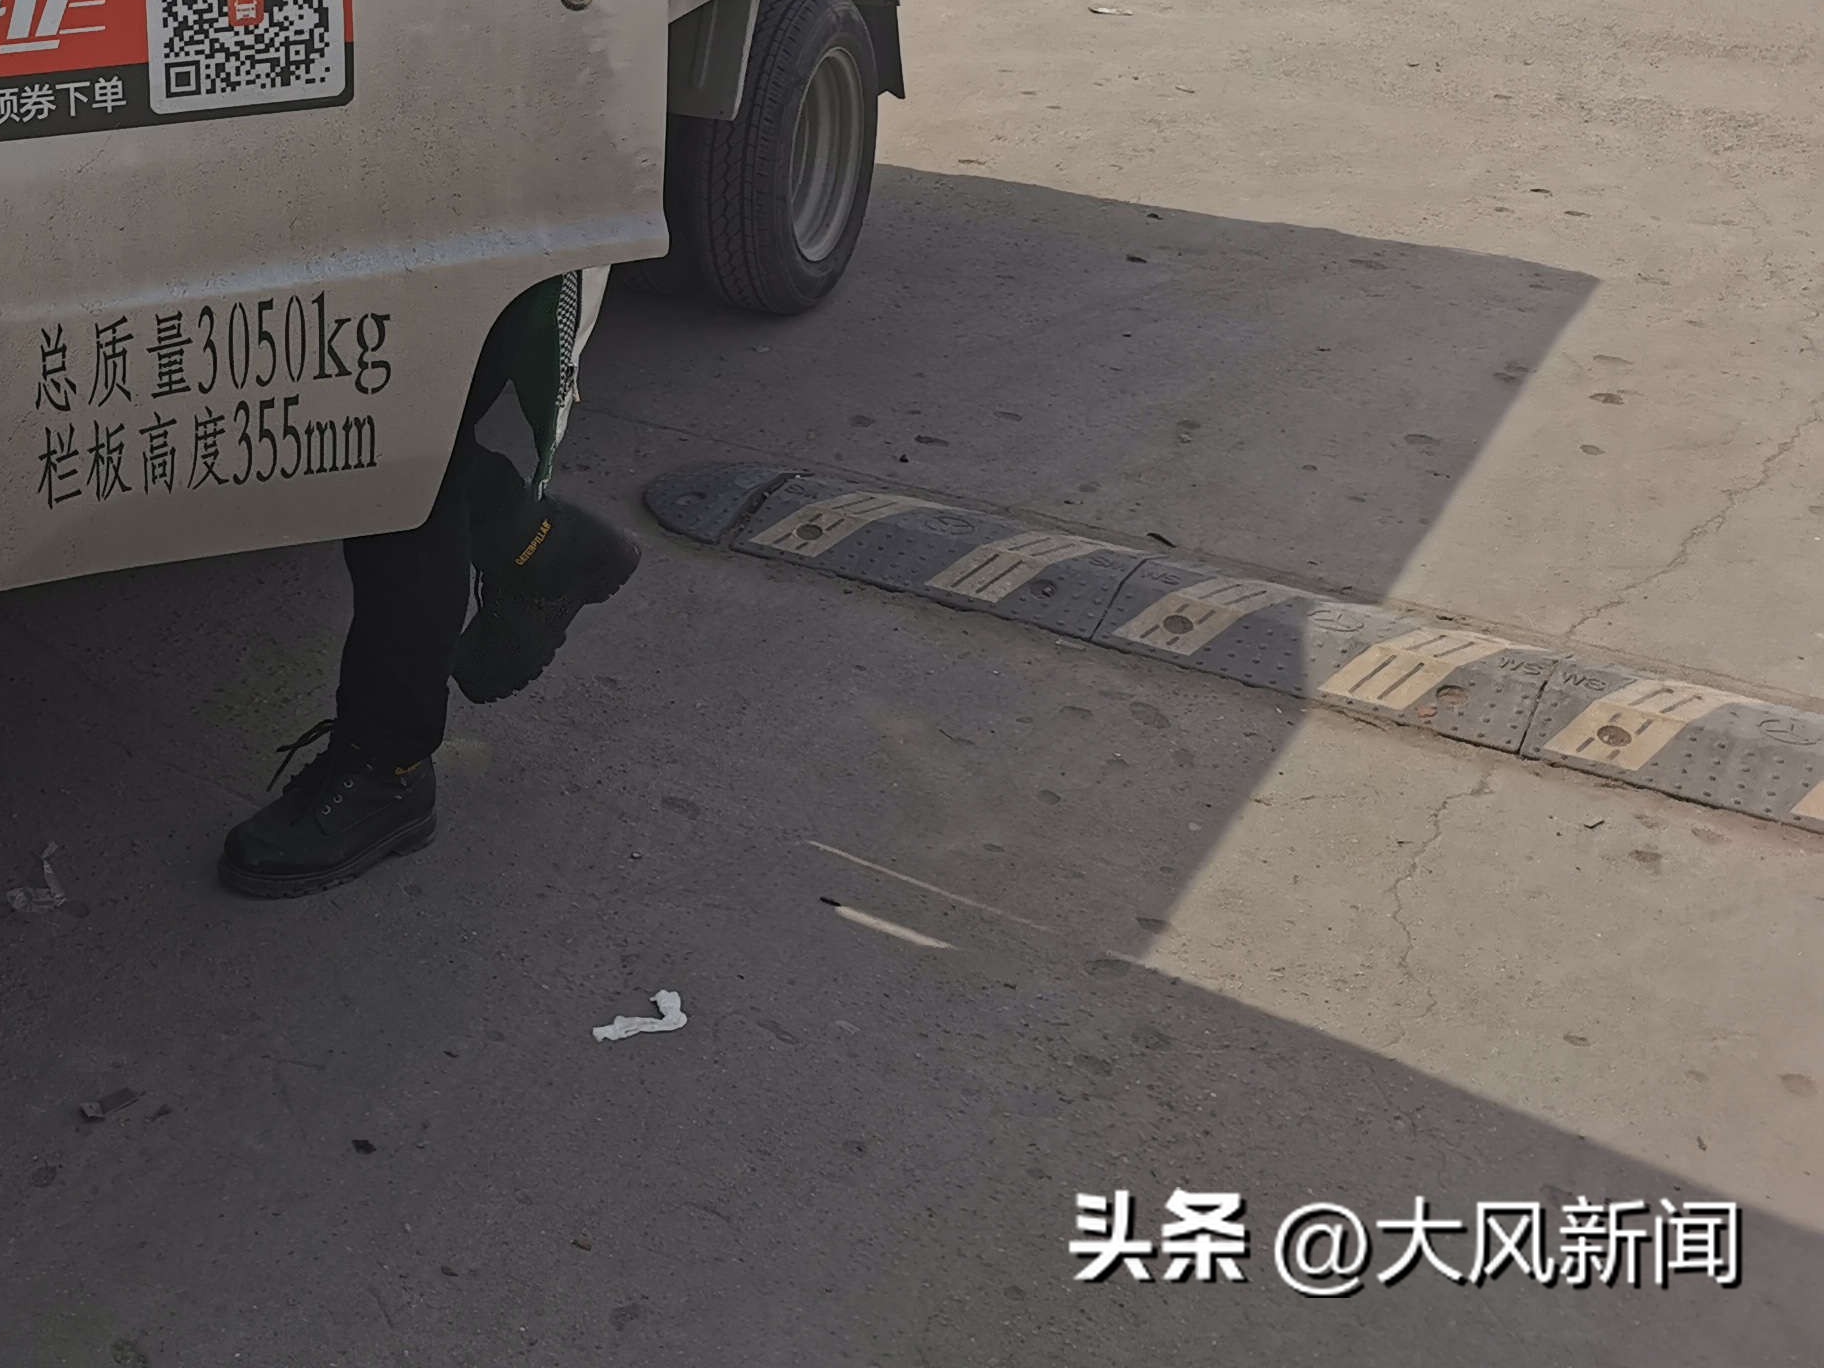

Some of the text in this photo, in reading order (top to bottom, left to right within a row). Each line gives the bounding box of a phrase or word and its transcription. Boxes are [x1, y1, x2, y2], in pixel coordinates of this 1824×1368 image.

[34, 290, 392, 412] 总质量3050kg
[36, 393, 379, 510] 栏板高度355mm
